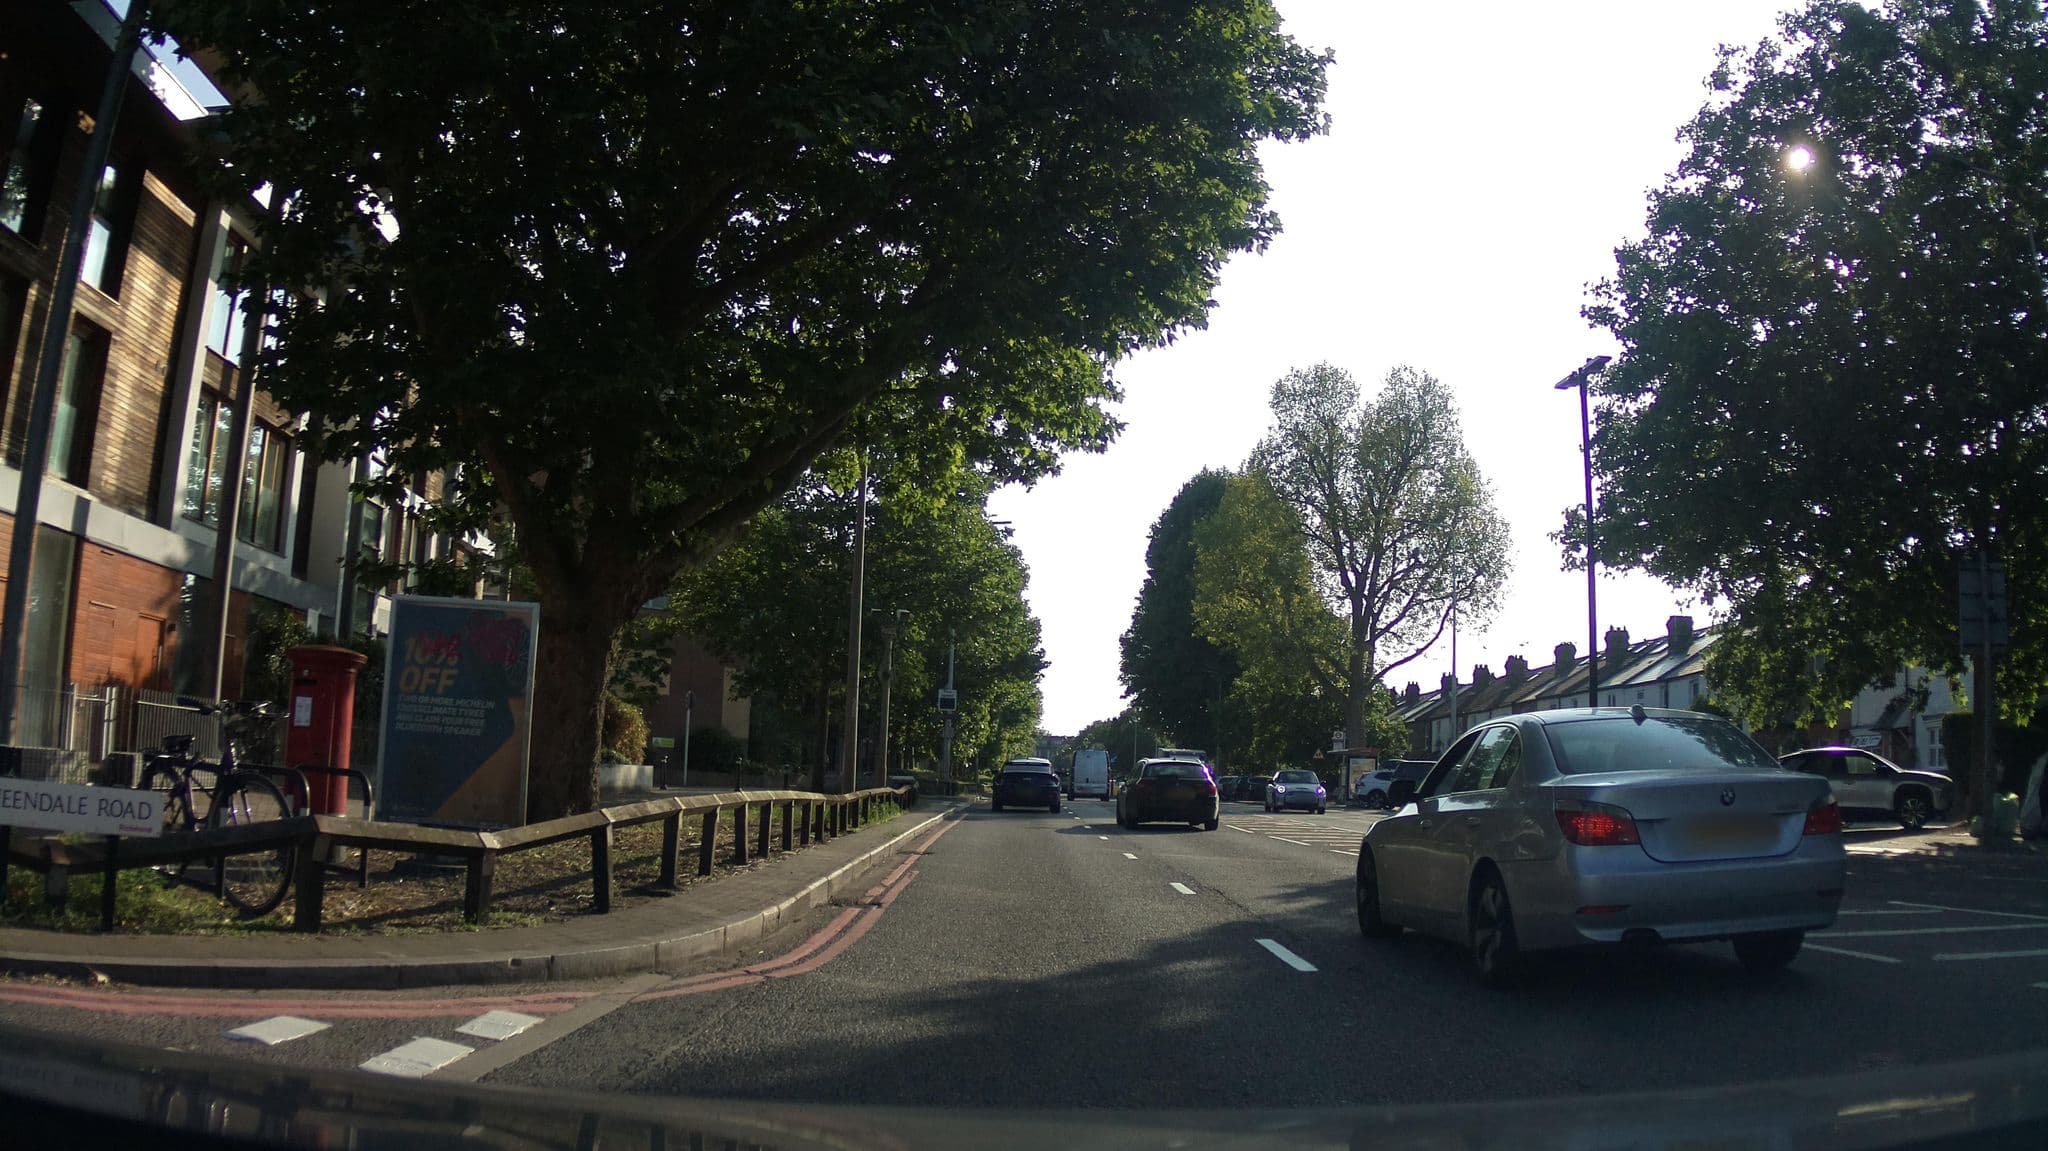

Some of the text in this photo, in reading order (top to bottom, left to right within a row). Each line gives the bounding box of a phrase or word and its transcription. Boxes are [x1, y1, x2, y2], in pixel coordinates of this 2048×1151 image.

[399, 667, 459, 694] OFF
[397, 704, 457, 715] CLIMATE
[0, 788, 152, 820] EENDALE ROAD
